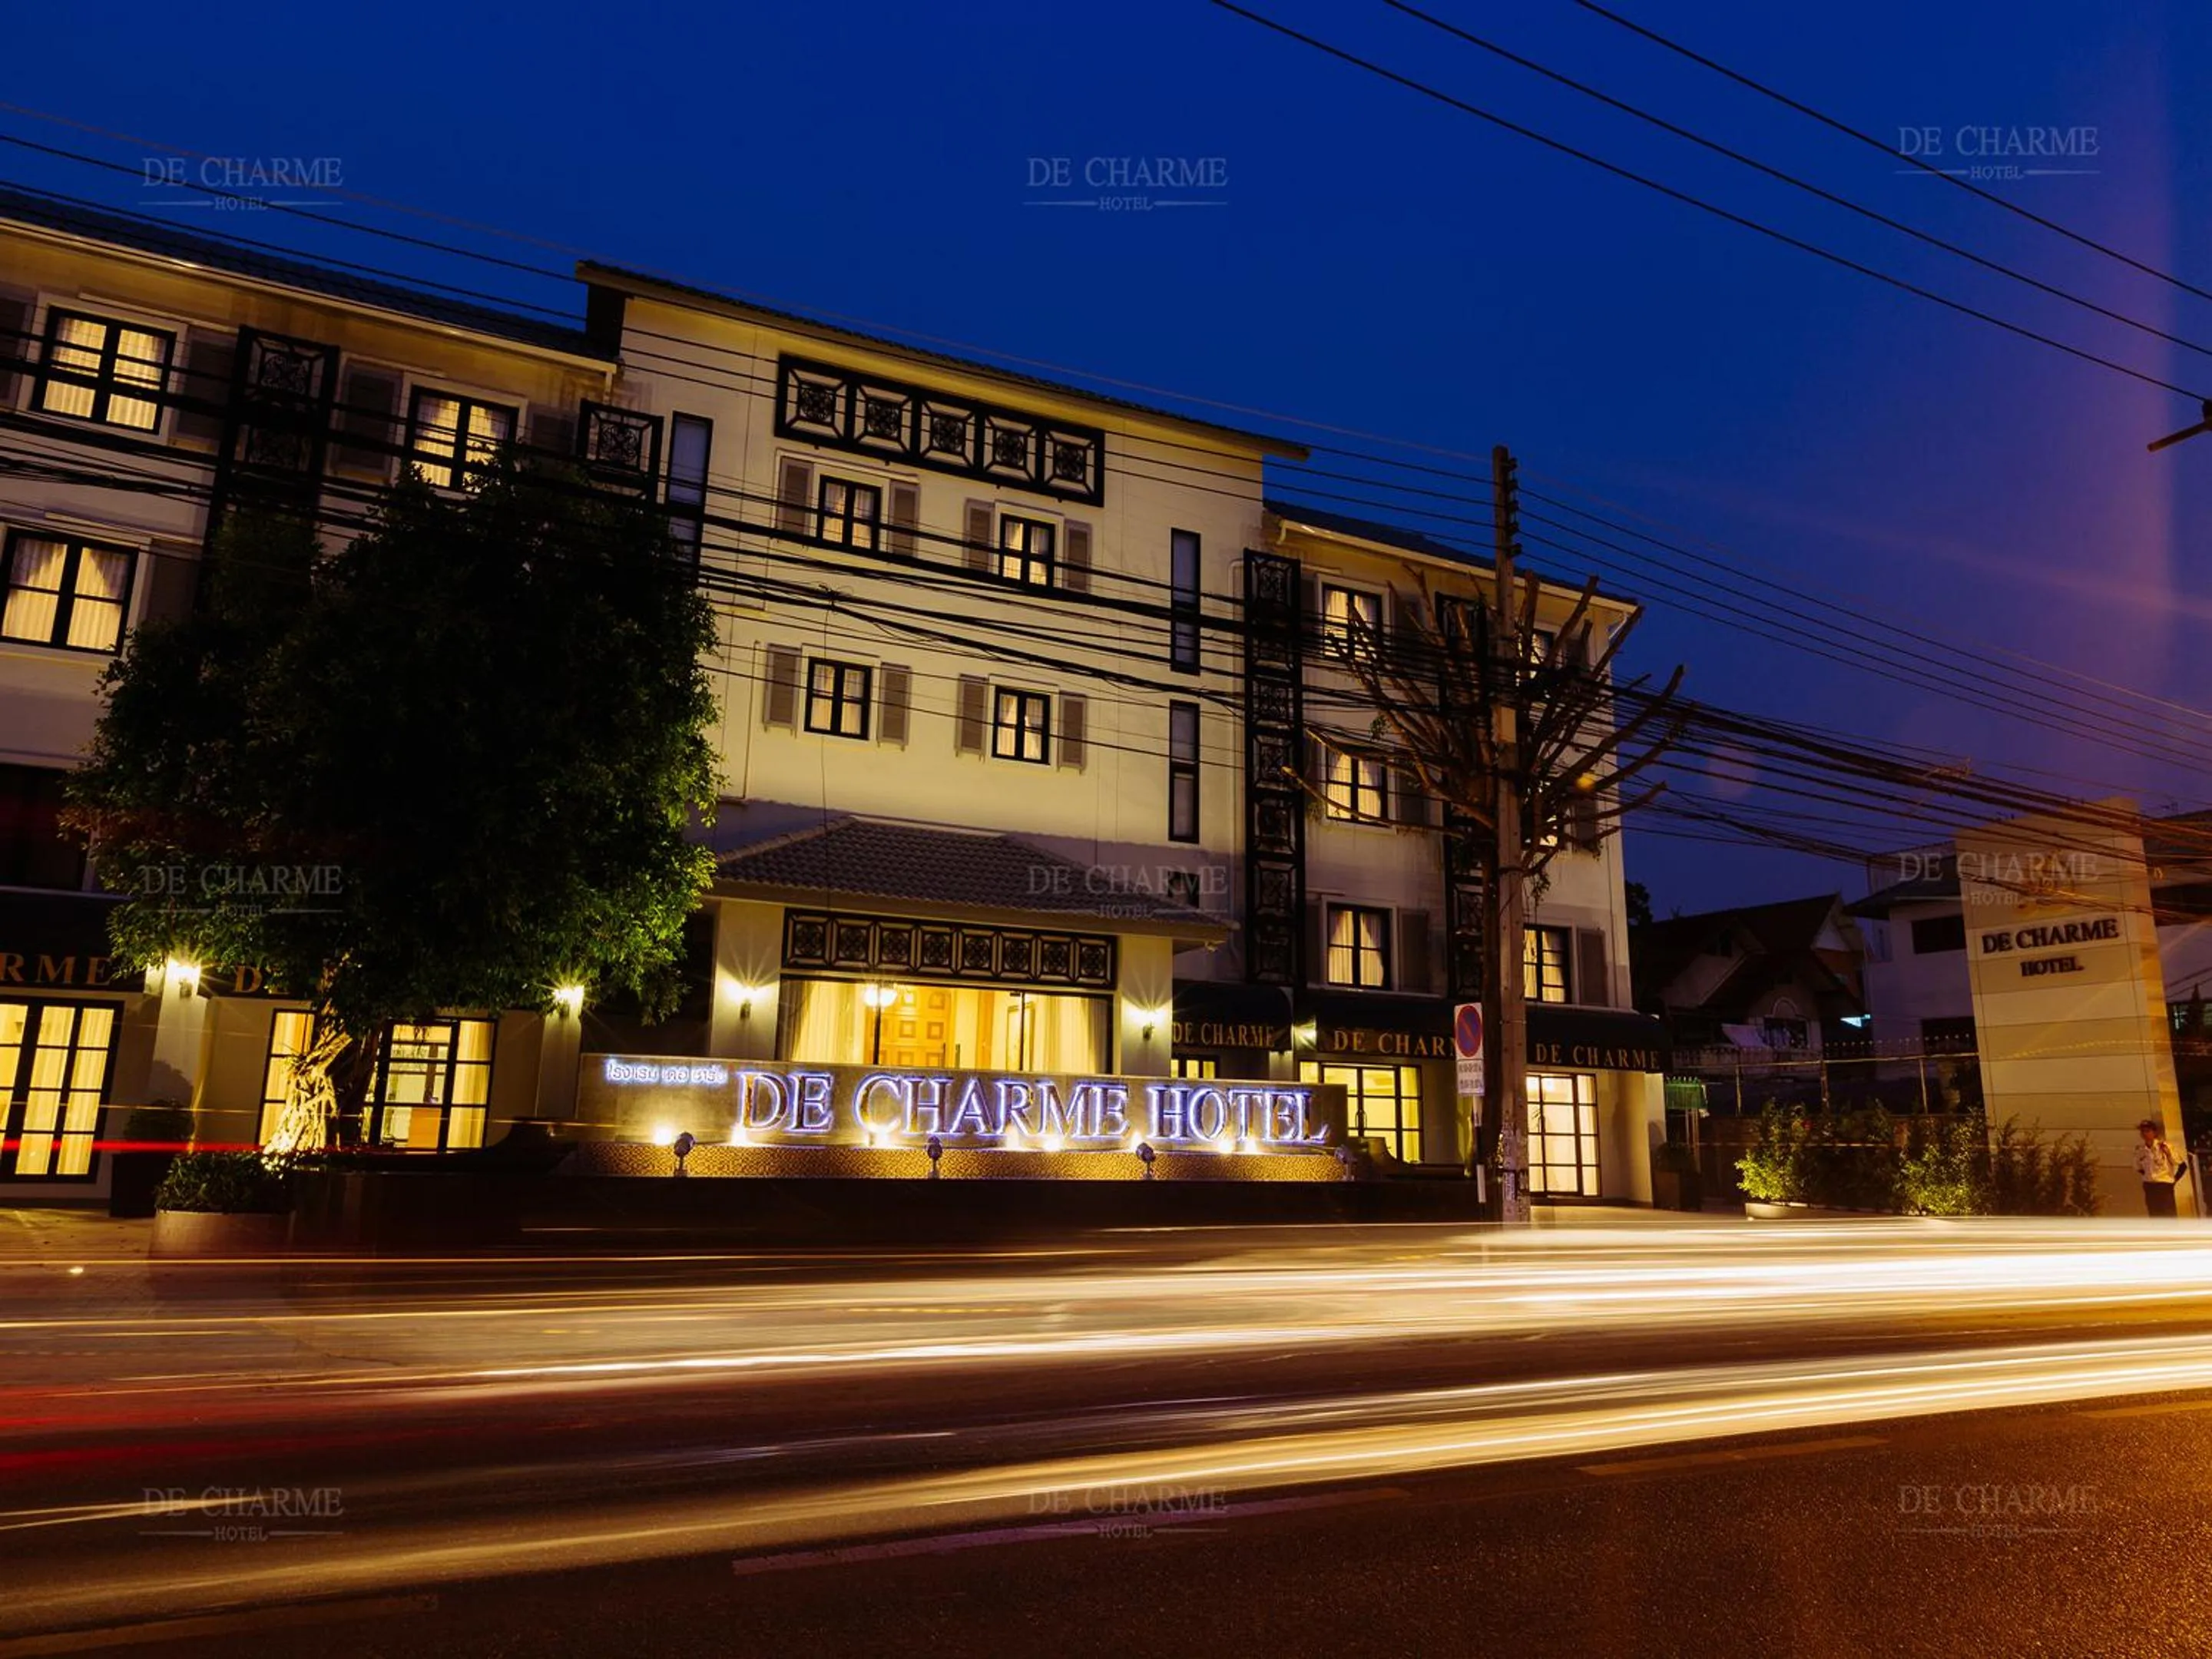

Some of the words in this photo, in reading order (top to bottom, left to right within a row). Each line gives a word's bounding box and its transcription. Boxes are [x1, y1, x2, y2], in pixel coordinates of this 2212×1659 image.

[1982, 932, 2013, 954] DE
[2015, 919, 2120, 949] CHARME
[2021, 956, 2085, 977] HOTEL
[1173, 1022, 1194, 1045] DE
[1201, 1022, 1275, 1048] CHARME
[1333, 1030, 1366, 1052] DE
[1378, 1033, 1456, 1057] CHAR
[1536, 1043, 1562, 1064] DE
[1574, 1045, 1661, 1070] CHARME
[734, 1071, 834, 1133] DE
[854, 1071, 1132, 1141] CHARME
[1146, 1084, 1330, 1144] HOTEL
